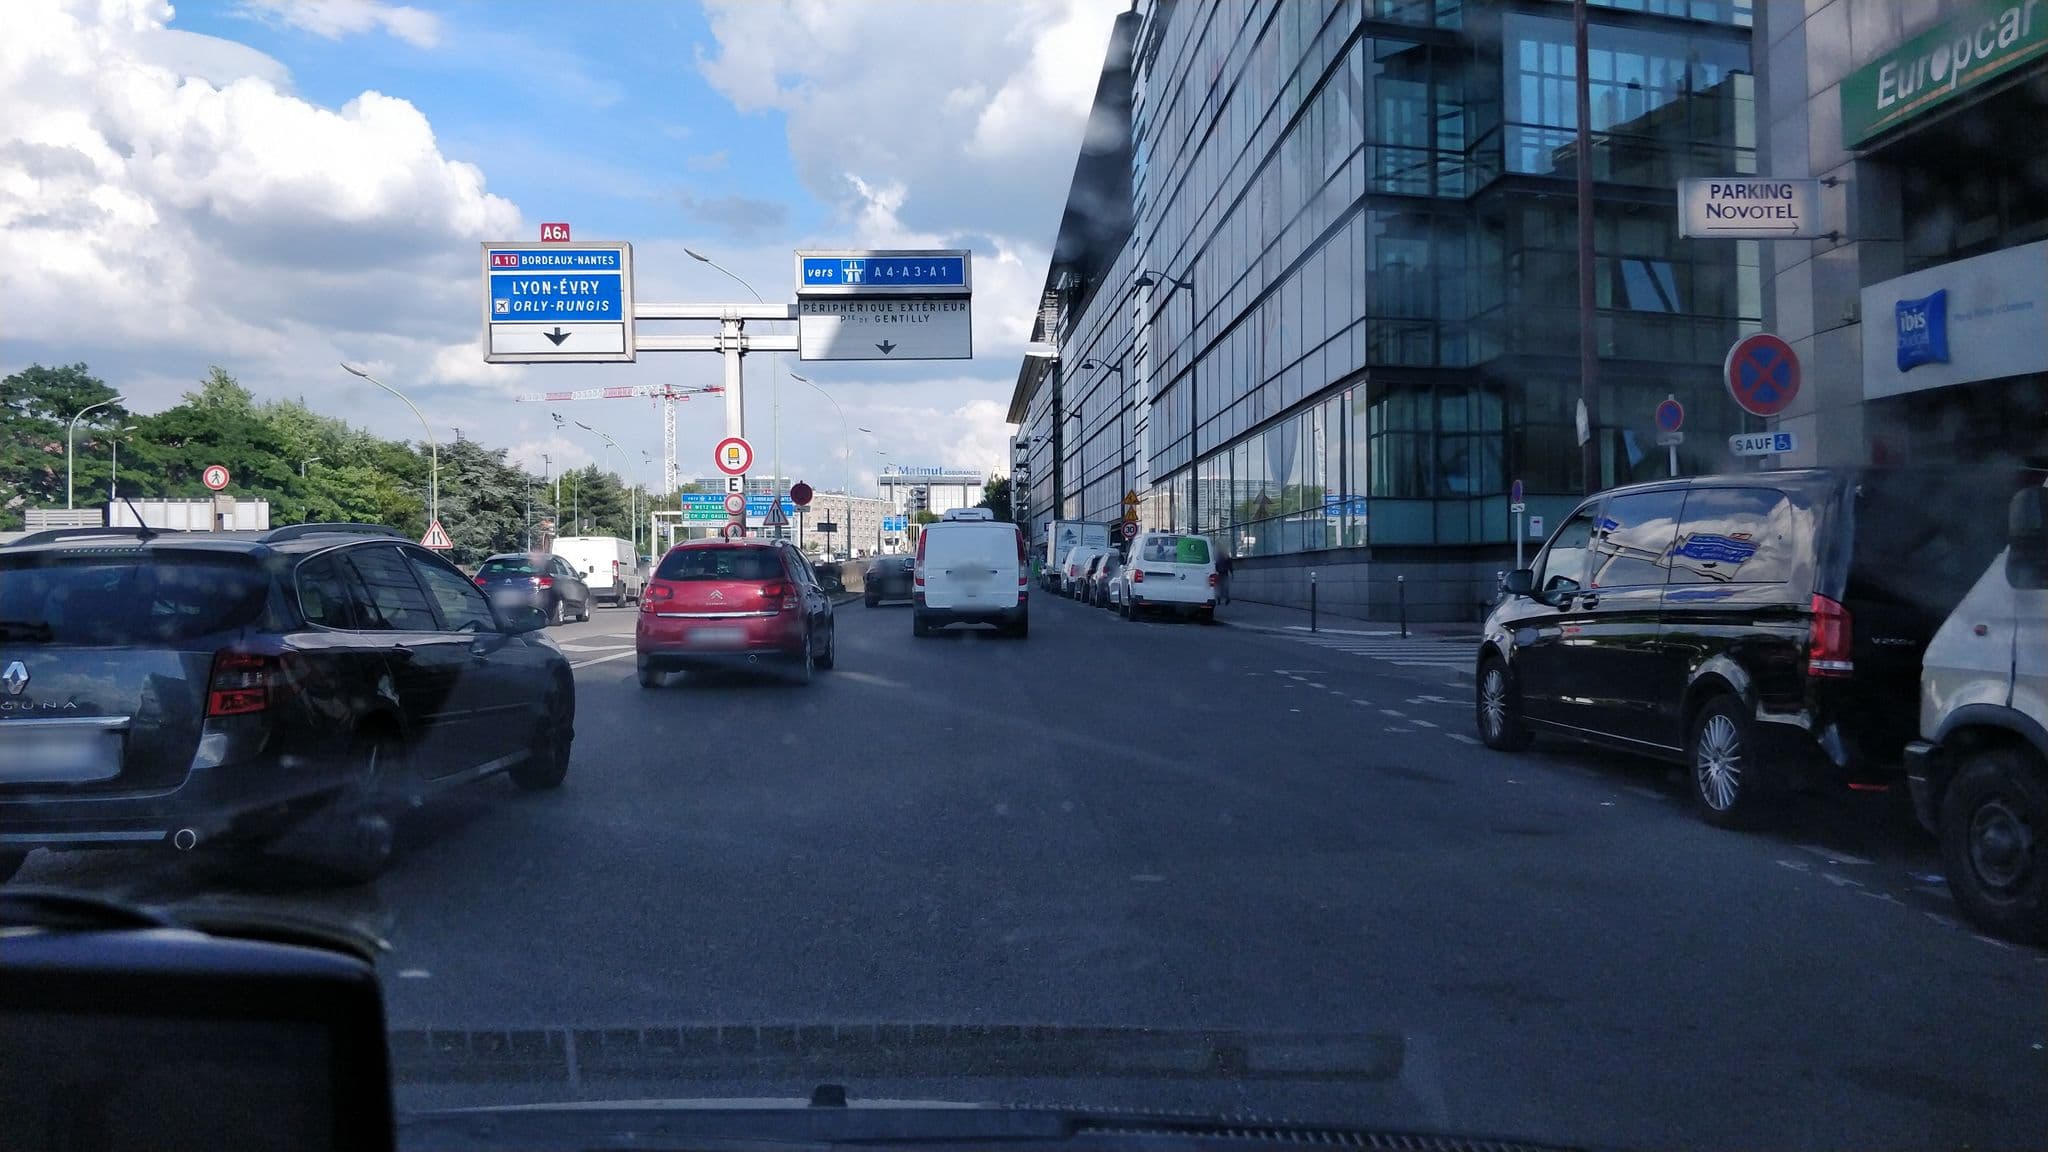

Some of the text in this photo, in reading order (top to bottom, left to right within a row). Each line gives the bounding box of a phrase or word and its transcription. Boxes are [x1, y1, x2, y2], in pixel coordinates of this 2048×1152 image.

[1877, 0, 2041, 110] Europcar
[1711, 184, 1793, 200] PARKING
[1706, 203, 1799, 219] NOVOTEL
[521, 256, 615, 265] BORDEAUX-NANTES
[807, 268, 833, 277] vers
[512, 278, 600, 295] LYON-ÉVRY
[513, 300, 610, 312] ORLY-RUNGIS
[803, 302, 966, 312] PÉRIPHÉRIQUE EXTÉRIEUR
[874, 315, 930, 323] GENTILLY
[1900, 308, 1926, 333] ibis
[1735, 438, 1771, 451] SAUF
[898, 466, 942, 475] Matmut
[729, 478, 739, 492] E
